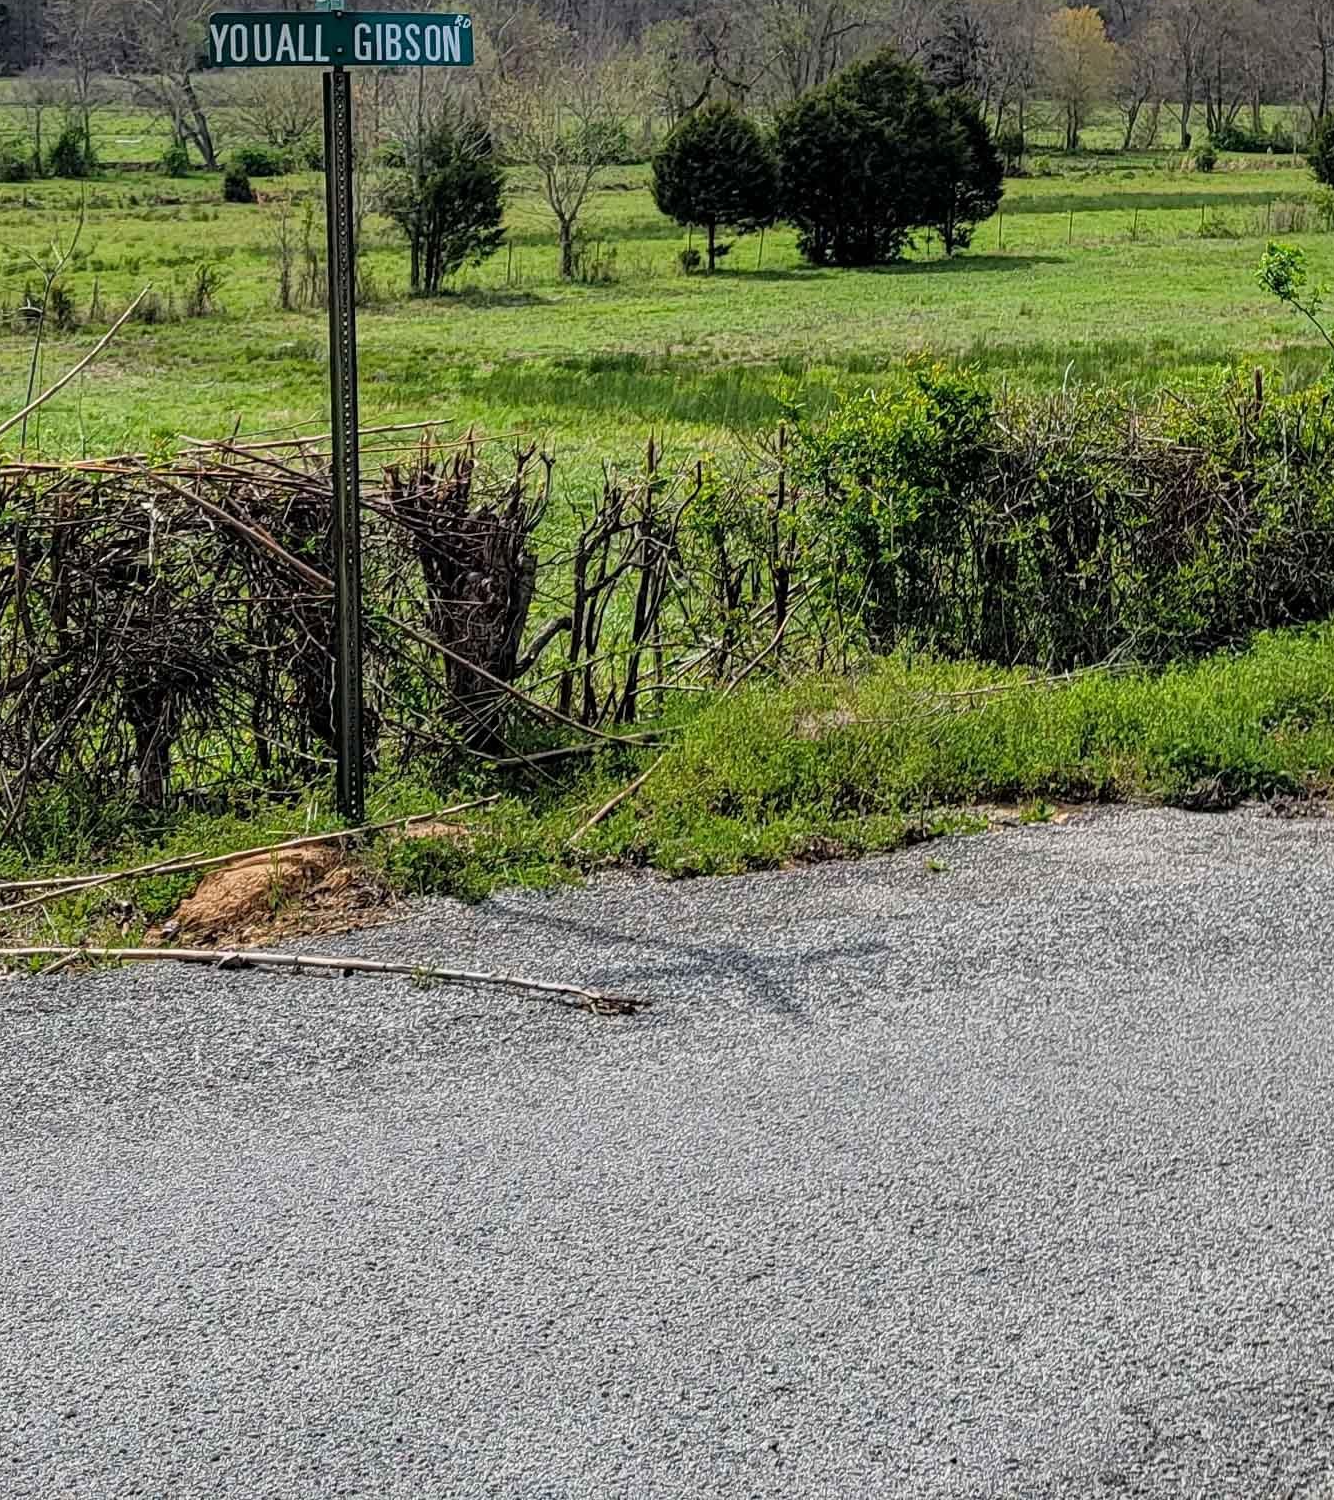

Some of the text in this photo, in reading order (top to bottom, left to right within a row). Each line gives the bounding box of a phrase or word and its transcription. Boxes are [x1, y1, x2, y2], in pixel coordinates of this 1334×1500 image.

[210, 14, 472, 63] YOUALL GIBSON RD
